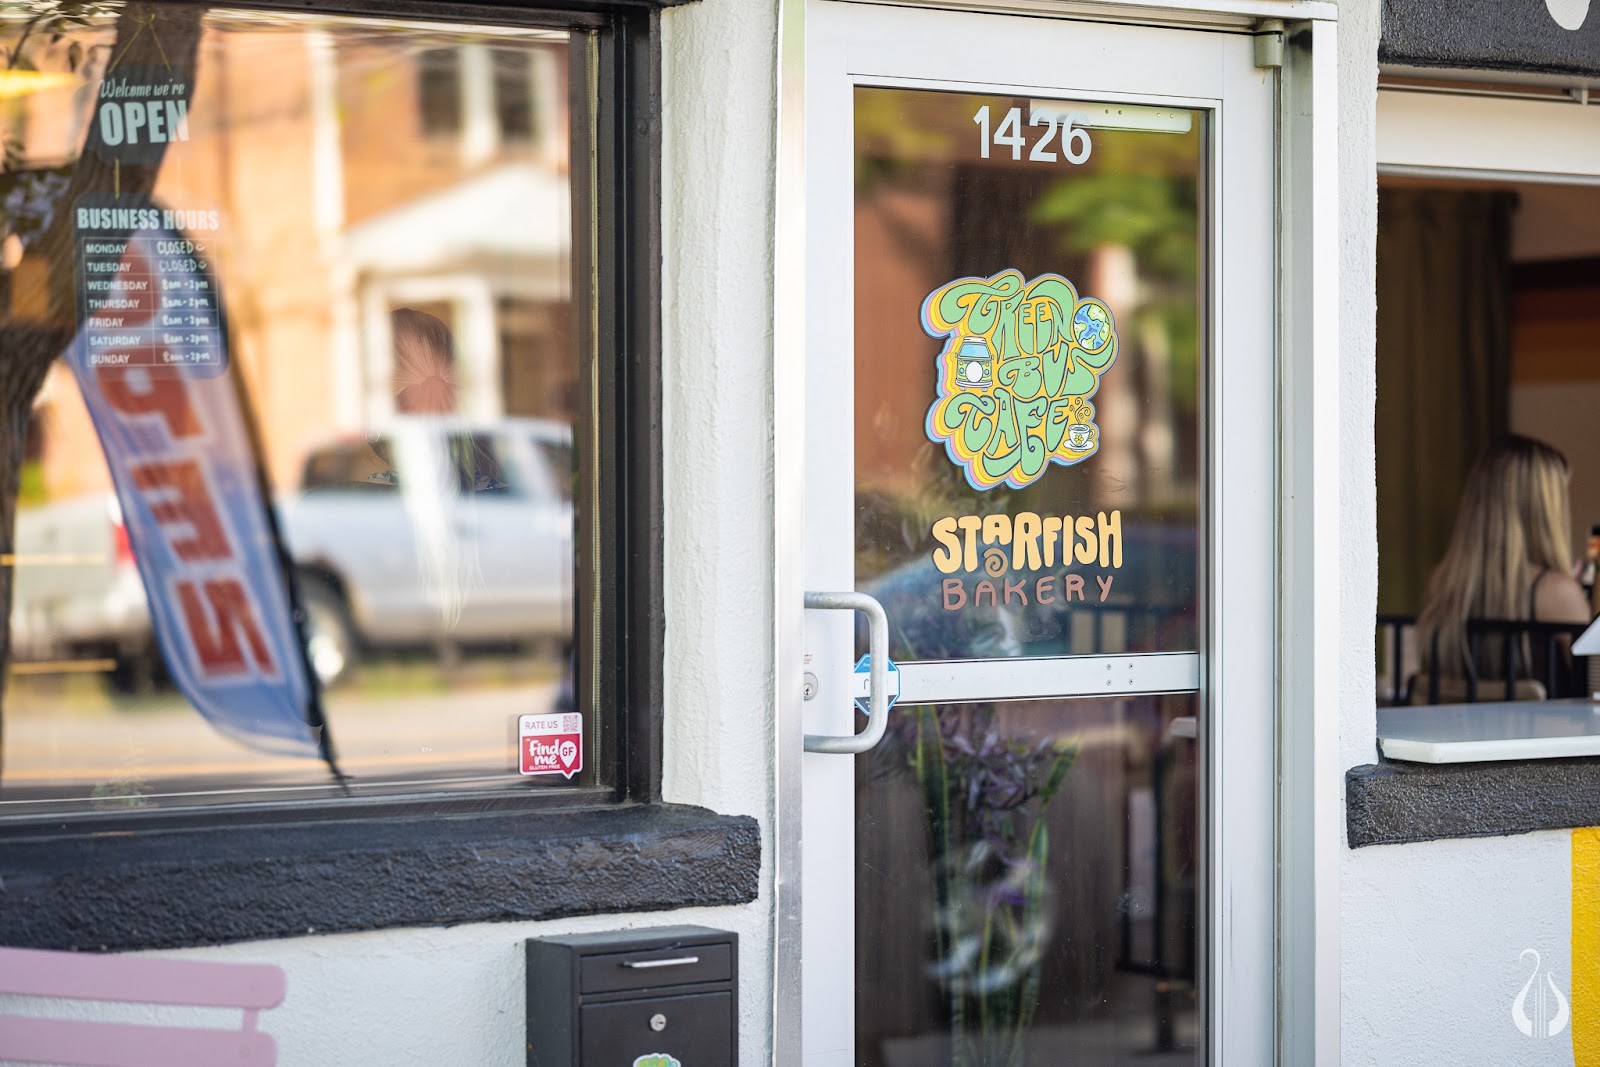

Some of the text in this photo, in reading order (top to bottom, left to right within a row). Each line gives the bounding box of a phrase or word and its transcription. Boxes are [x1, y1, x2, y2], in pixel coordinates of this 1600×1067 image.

[98, 78, 186, 98] Welcome we're
[100, 100, 190, 146] OPEN
[973, 105, 1093, 165] 1426
[77, 208, 219, 231] BUSINESS HOURS
[86, 241, 194, 255] MONDAY CLOSED
[87, 258, 197, 272] TUESDAY CLOSED
[88, 281, 148, 291] WEDNESDAY
[88, 299, 141, 309] THURSDAY
[89, 318, 125, 327] FRIDAY
[939, 275, 1074, 363] GREEN
[90, 336, 141, 346] SATURDAY
[90, 354, 131, 364] SUNDAY
[997, 336, 1114, 399] BUS
[944, 388, 1070, 478] CAFE
[932, 510, 1123, 574] STARFISH
[942, 574, 1114, 611] BAKERY
[525, 721, 558, 730] RATE US
[563, 747, 574, 757] GF
[534, 755, 557, 765] me
